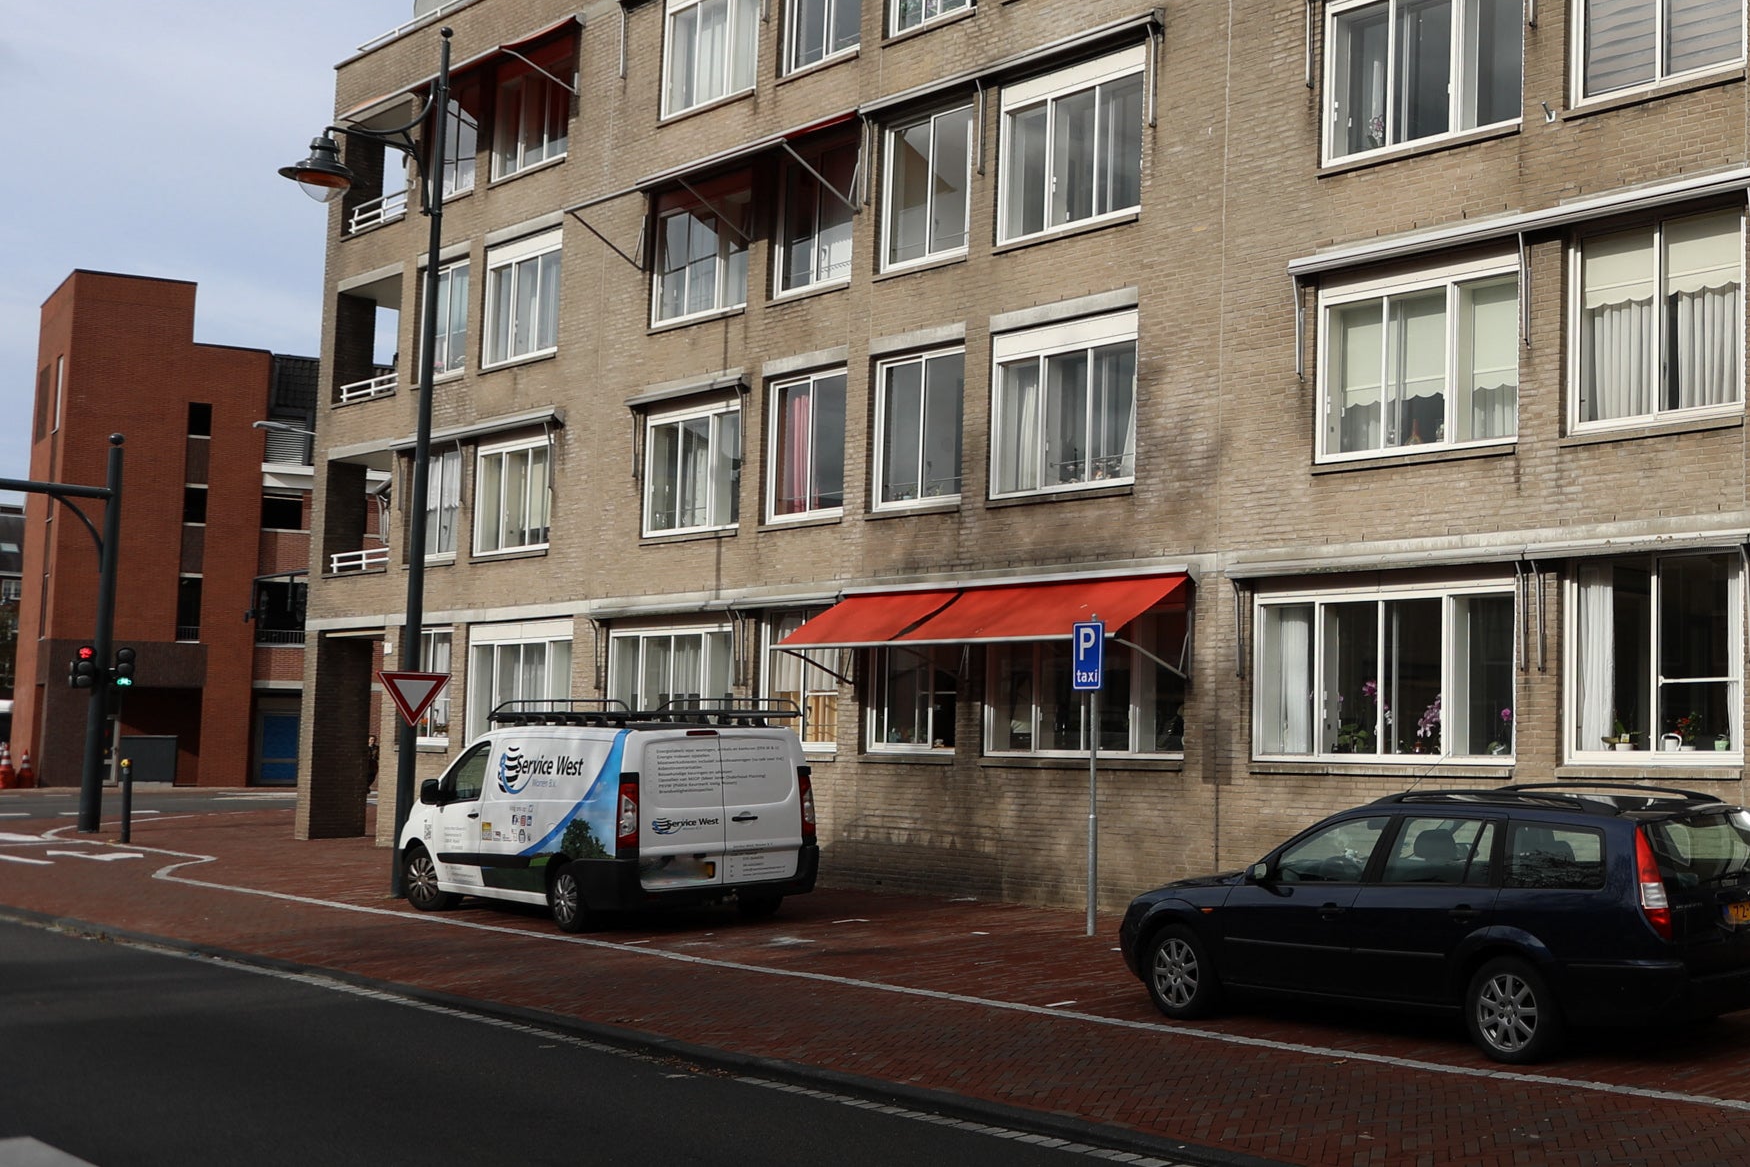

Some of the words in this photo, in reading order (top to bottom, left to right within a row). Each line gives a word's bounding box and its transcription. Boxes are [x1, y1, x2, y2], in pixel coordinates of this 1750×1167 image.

[1079, 627, 1096, 661] P
[1076, 668, 1098, 683] taxi
[515, 754, 553, 775] Service
[556, 755, 584, 776] West
[667, 819, 697, 828] Service
[698, 818, 719, 826] West
